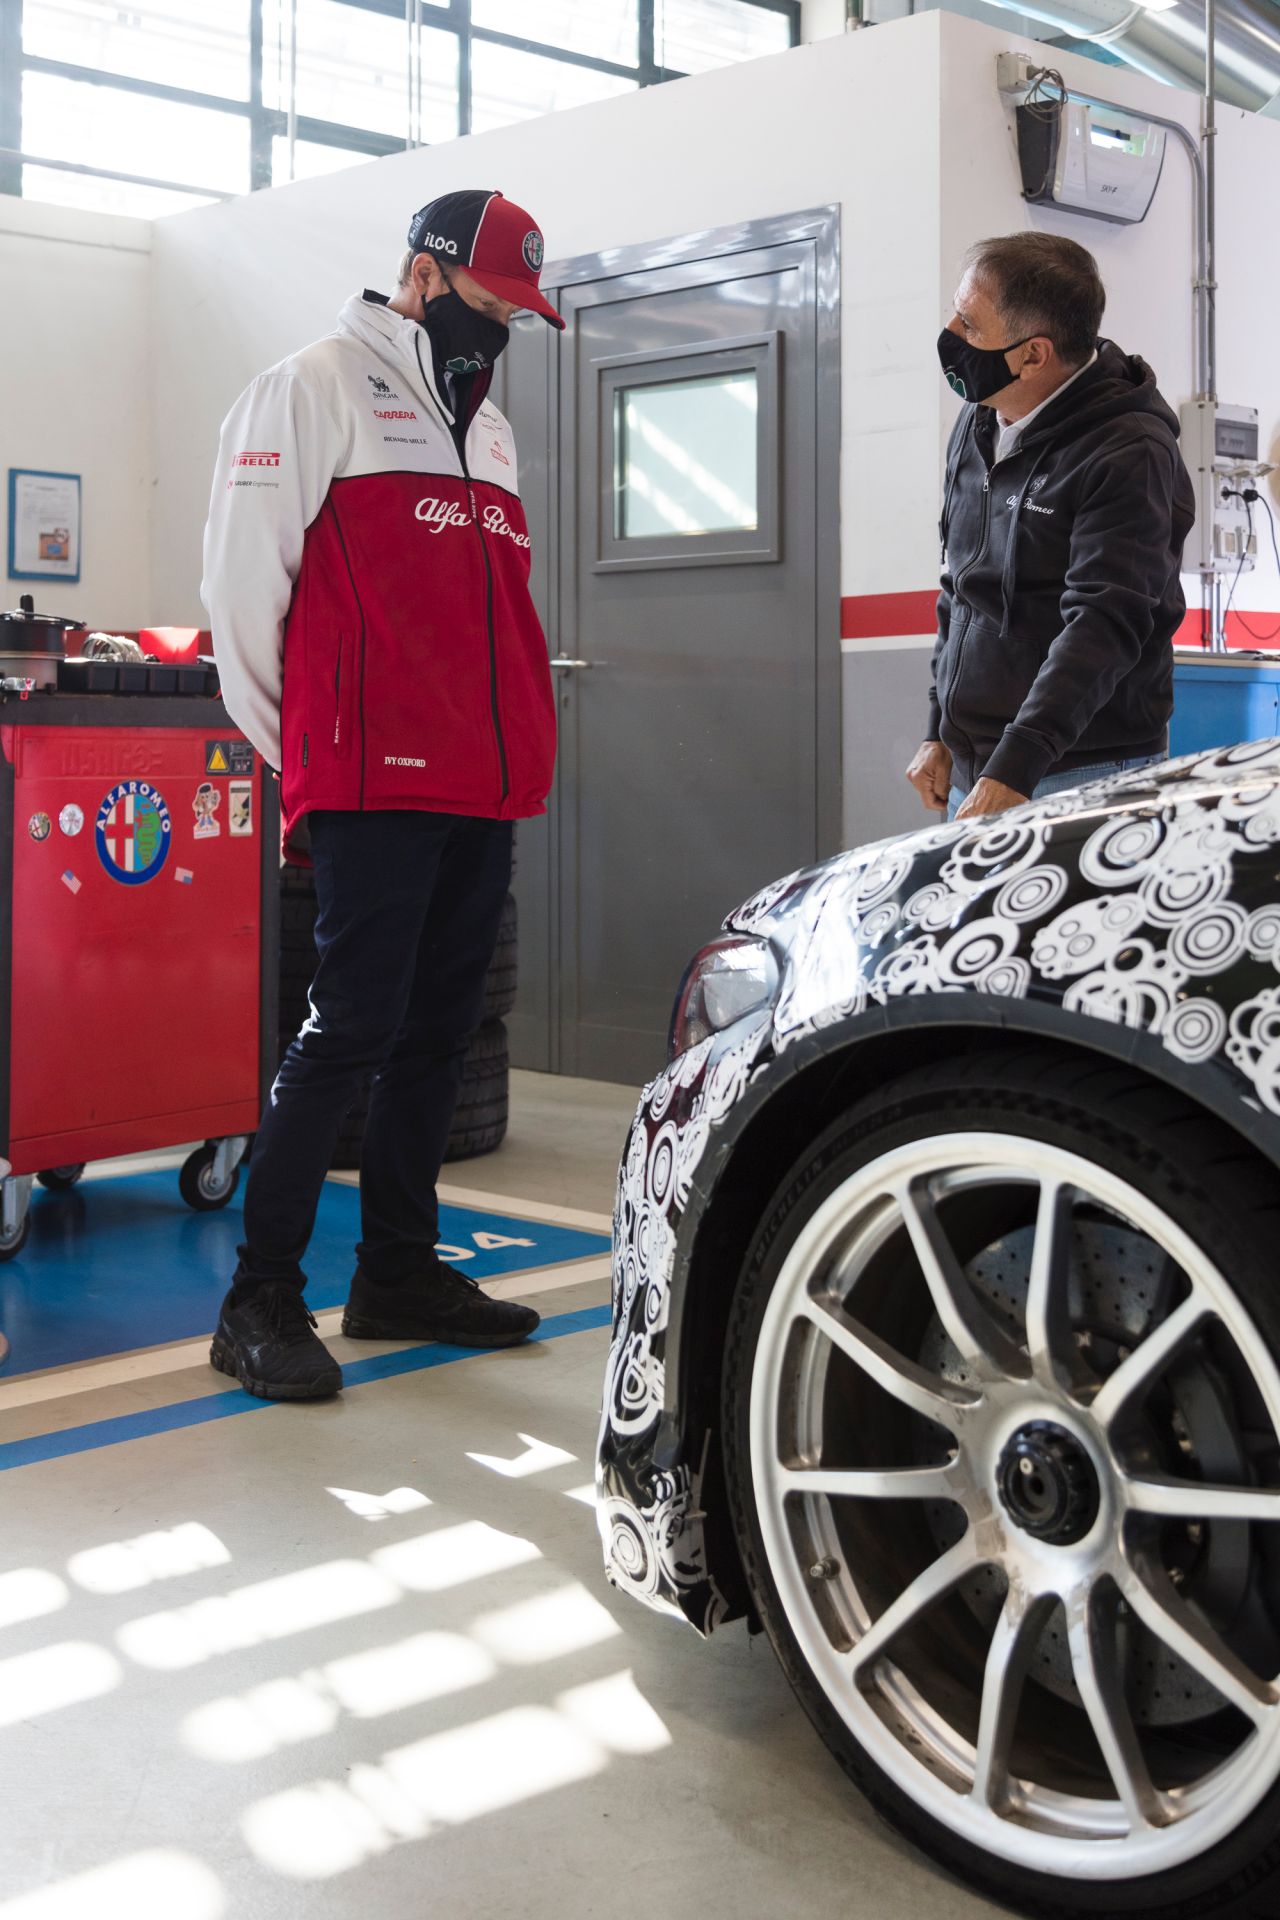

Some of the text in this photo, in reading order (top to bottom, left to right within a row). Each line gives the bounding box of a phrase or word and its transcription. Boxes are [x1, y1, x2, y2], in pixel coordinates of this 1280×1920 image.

[424, 232, 458, 256] iLOQ
[373, 409, 417, 420] CARRERA
[1022, 497, 1055, 515] Romeo
[414, 497, 472, 534] Alfa
[384, 756, 427, 768] IVY OXFORD
